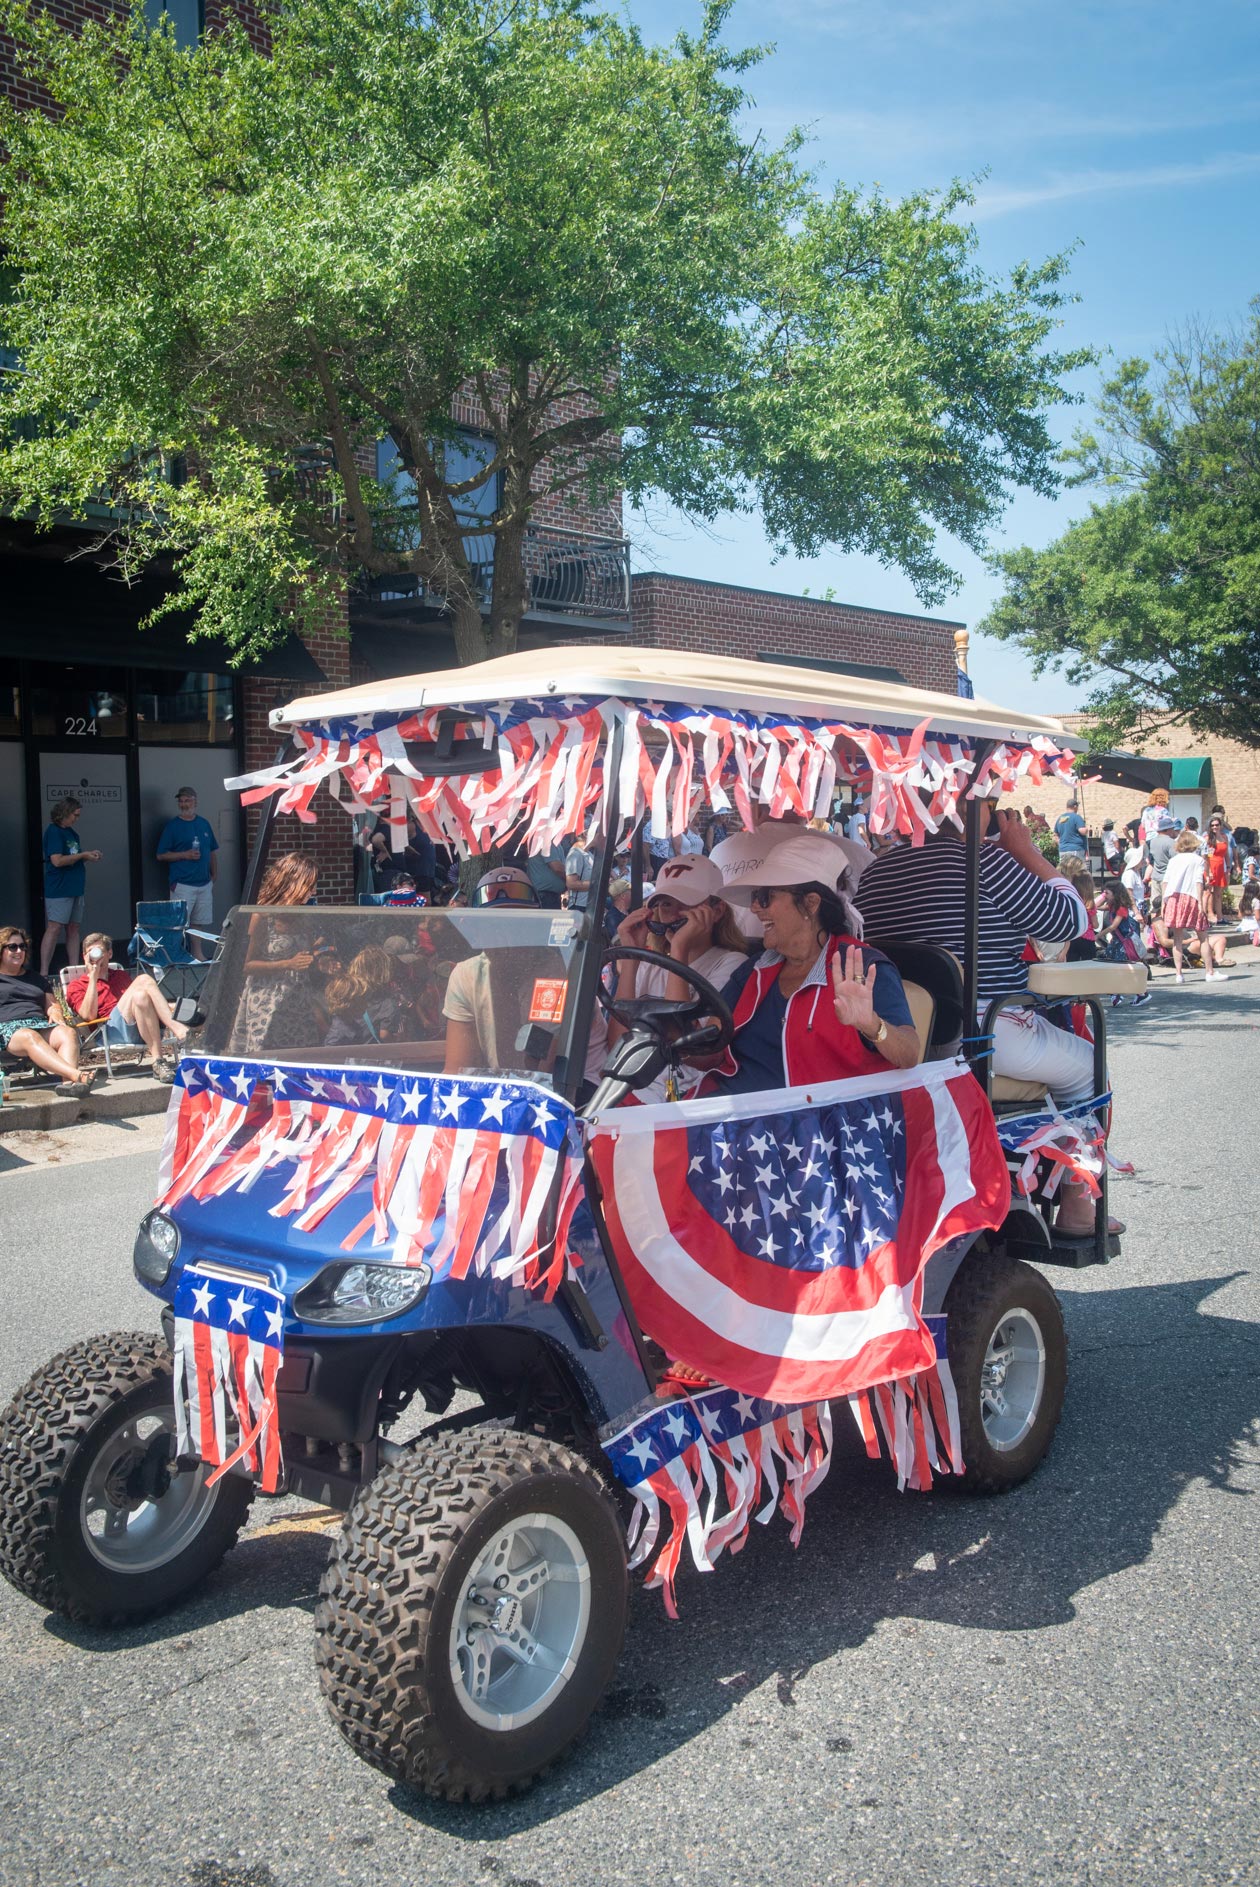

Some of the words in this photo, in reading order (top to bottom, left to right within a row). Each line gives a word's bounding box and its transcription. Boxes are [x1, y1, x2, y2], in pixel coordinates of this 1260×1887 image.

[65, 717, 97, 736] 224
[50, 789, 75, 797] CAPE
[77, 790, 118, 798] CHARLES
[664, 864, 694, 879] VT
